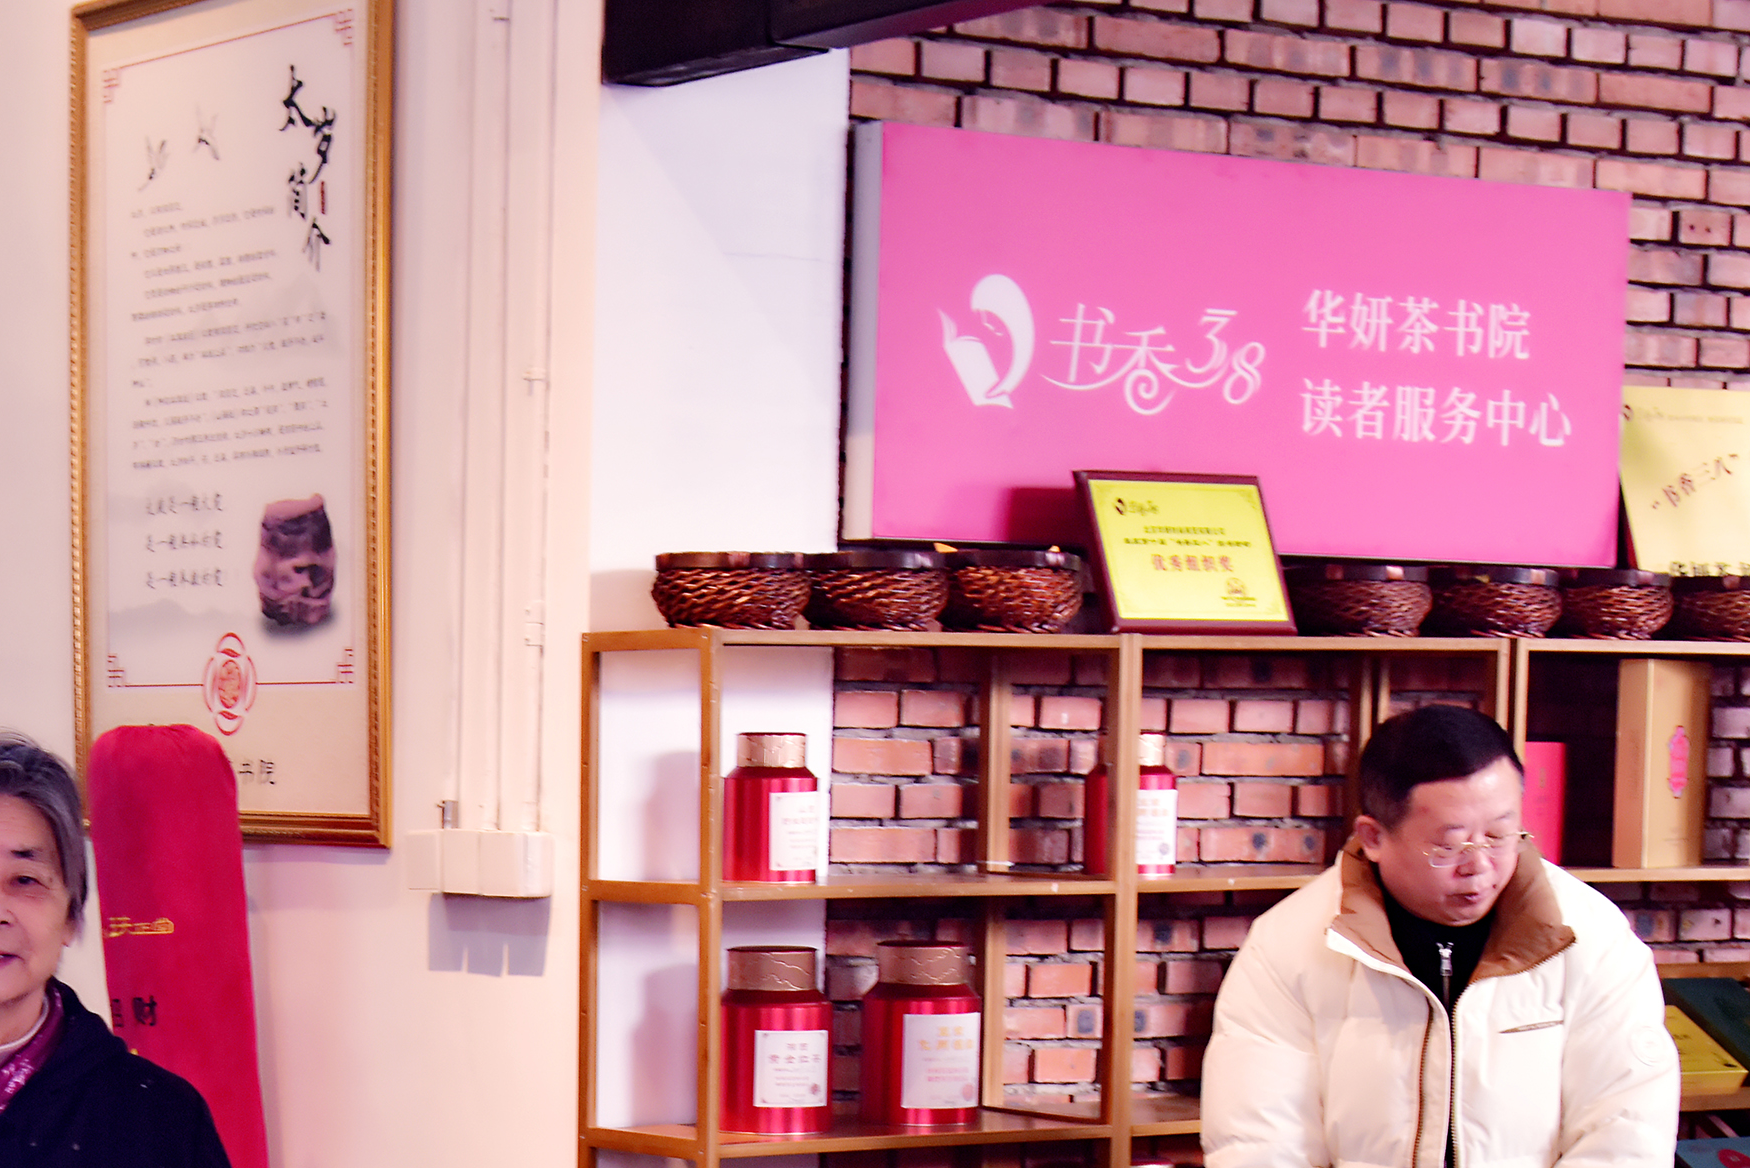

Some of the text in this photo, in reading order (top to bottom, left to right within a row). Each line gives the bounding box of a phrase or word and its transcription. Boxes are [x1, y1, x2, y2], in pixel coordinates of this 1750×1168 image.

[1301, 288, 1532, 362] 华妍茶书院
[1300, 378, 1573, 449] 读者服务中心
[228, 758, 278, 786] 书院
